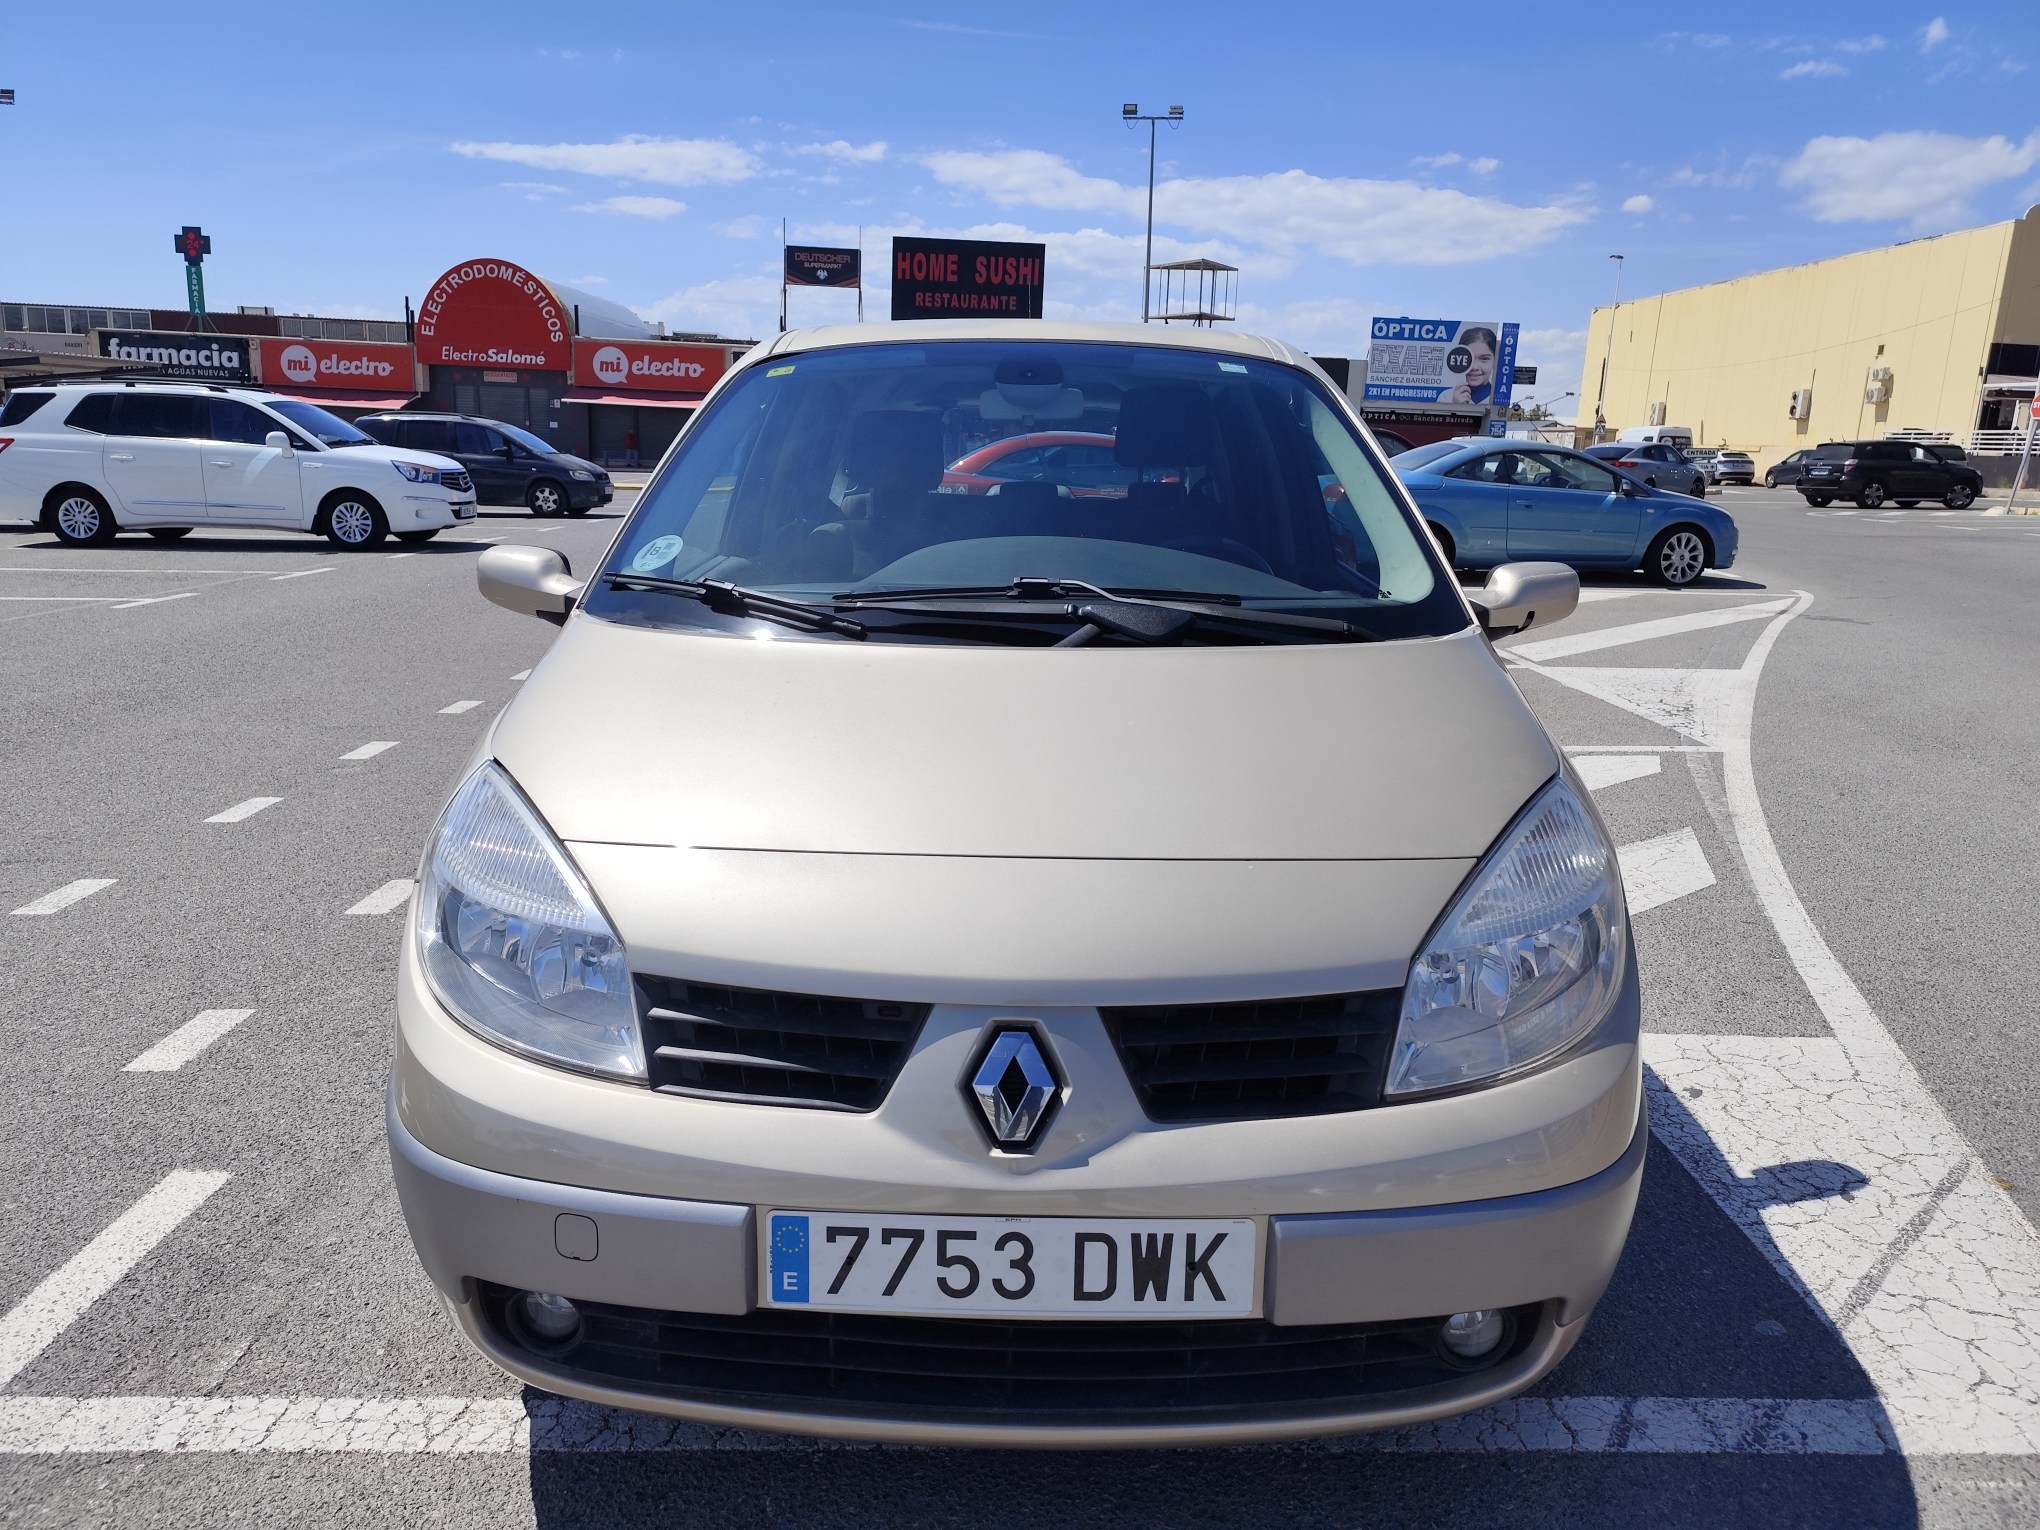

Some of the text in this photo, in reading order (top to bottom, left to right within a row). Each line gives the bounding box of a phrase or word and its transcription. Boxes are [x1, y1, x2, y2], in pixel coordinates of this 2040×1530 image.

[795, 252, 851, 263] DEUTSCHER
[803, 261, 843, 269] SUPERMARKT
[897, 252, 1040, 286] HOME SUSHI
[191, 267, 200, 314] FARMACIA
[421, 264, 564, 343] ELECTRODOMÉSTICOS
[915, 291, 1017, 311] RESTAURANTE
[1373, 319, 1448, 340] ÓPTICA
[108, 337, 240, 368] farmacia
[441, 345, 546, 365] ElectroSalomé
[1449, 355, 1468, 366] EYE
[197, 368, 229, 378] NUEVAS
[287, 353, 394, 377] mi electro
[599, 354, 705, 378] mi electro
[1369, 375, 1442, 385] SÁNCHEZ BARREDO
[1368, 387, 1438, 398] 2X1 EN PROGRESIVOS
[1445, 416, 1473, 424] Barredo
[825, 1226, 1229, 1303] 7753 DWK
[782, 1271, 799, 1291] E
